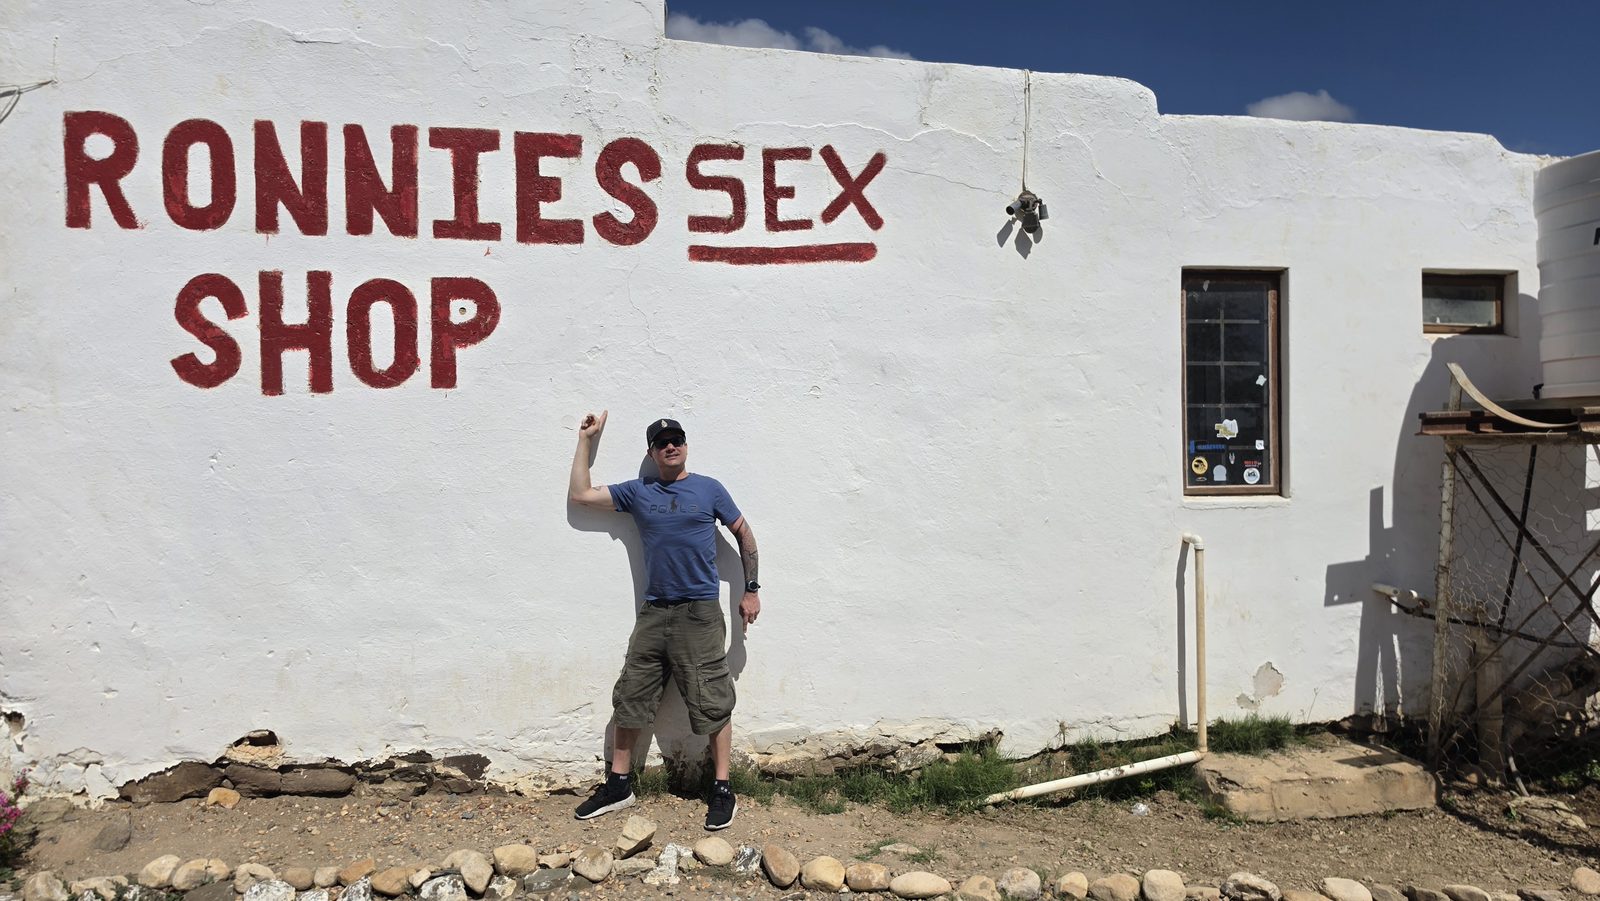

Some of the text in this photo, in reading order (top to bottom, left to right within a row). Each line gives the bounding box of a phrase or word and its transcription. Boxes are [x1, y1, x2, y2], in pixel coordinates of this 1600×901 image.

[63, 111, 887, 246] RONNIES SEX
[170, 270, 502, 397] SHOP
